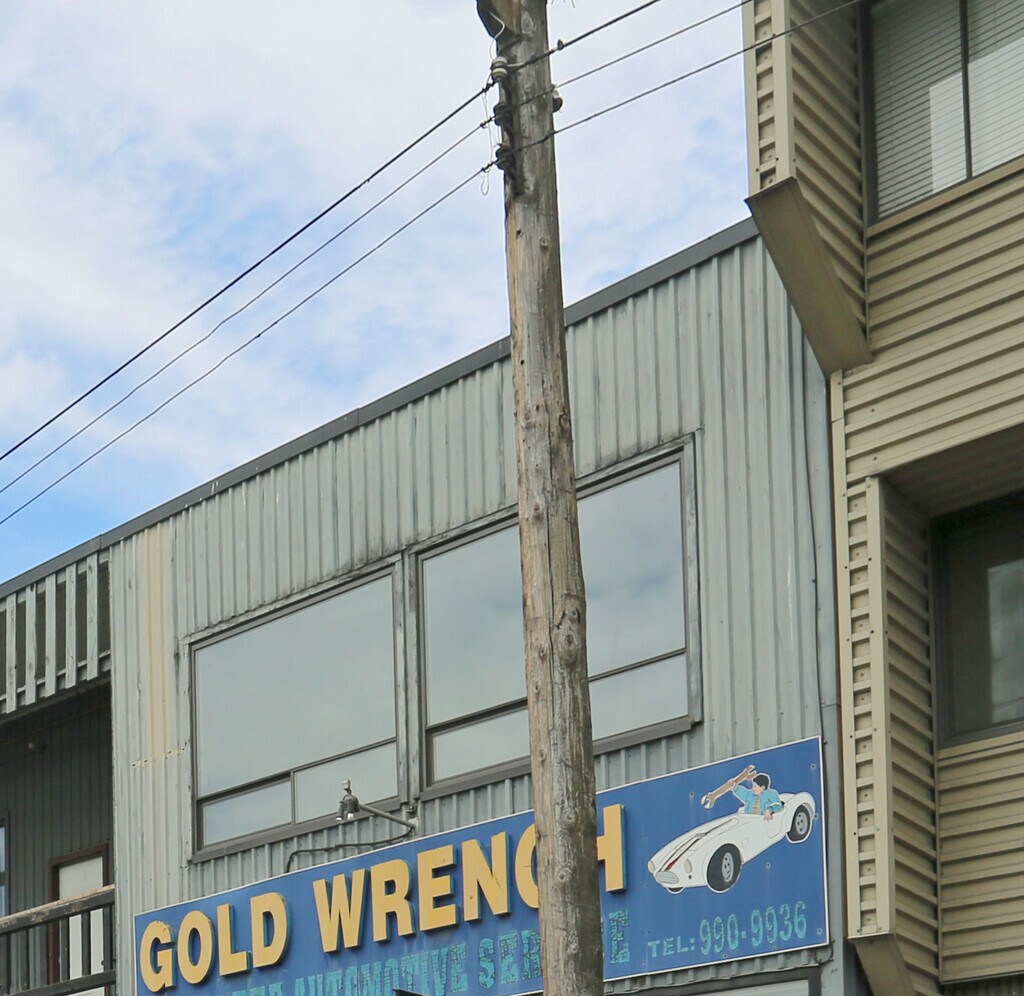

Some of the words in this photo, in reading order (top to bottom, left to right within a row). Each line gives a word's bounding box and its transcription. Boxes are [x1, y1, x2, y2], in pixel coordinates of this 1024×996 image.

[140, 891, 289, 993] GOLD
[478, 910, 631, 990] SERE
[647, 935, 696, 959] TEL:
[699, 901, 807, 956] 990-9936
